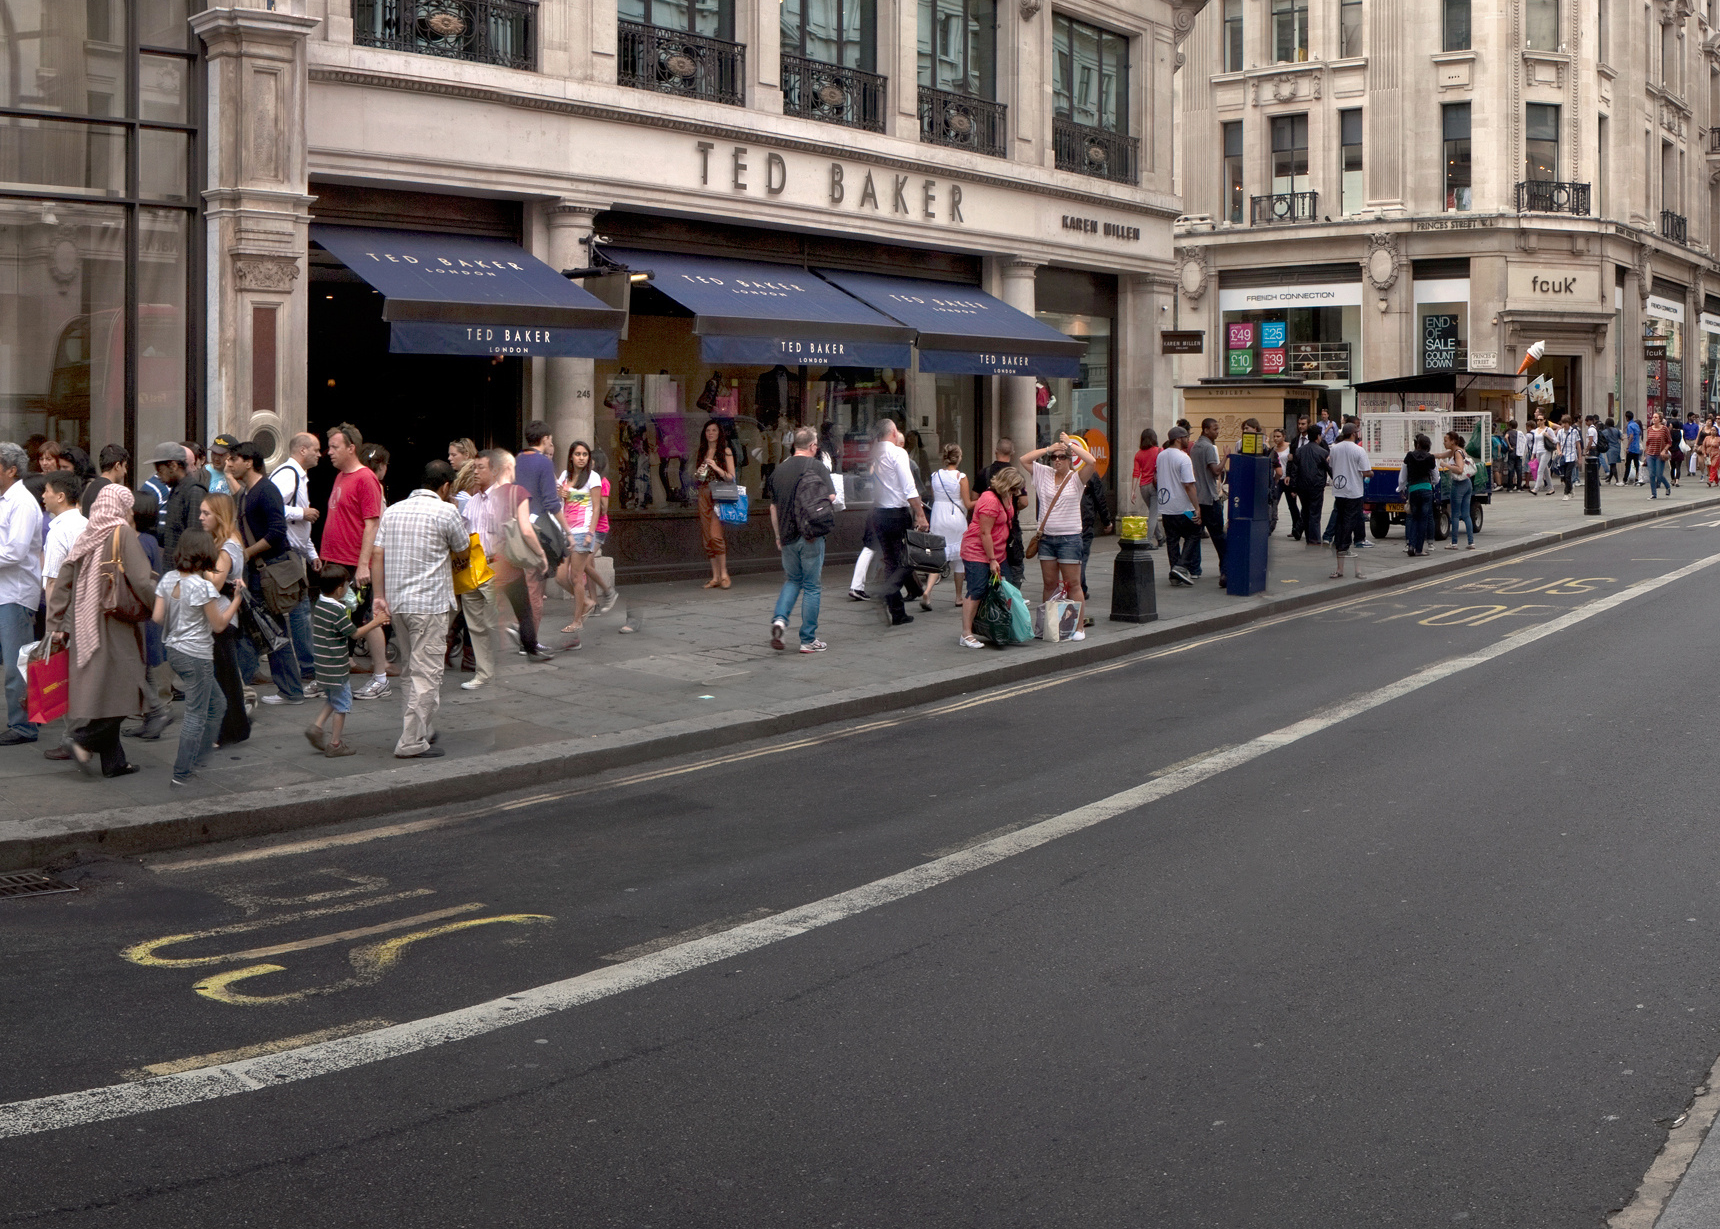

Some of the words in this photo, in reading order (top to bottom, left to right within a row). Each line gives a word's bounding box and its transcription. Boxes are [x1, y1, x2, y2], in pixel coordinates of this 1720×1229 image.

[697, 140, 787, 195] TED
[829, 162, 964, 223] BAKER
[1061, 214, 1098, 234] KAREN
[1103, 222, 1141, 241] MILLEN
[1416, 220, 1448, 230] PRINCES
[1450, 218, 1477, 228] STREET
[365, 252, 419, 264] TED
[437, 257, 524, 271] BAKER
[425, 267, 497, 277] LONDON
[681, 274, 724, 286] TED
[735, 279, 806, 292] BAKER
[1531, 275, 1575, 294] fcuk
[888, 294, 925, 304] TED
[932, 298, 989, 309] BAKER
[1246, 294, 1278, 302] FRENCH
[1279, 291, 1335, 300] CONNECTION
[1425, 316, 1450, 328] END
[467, 328, 493, 341] TED
[504, 329, 551, 343] BAKER
[1230, 328, 1251, 341] £49
[1263, 327, 1283, 340] £25
[1425, 327, 1443, 339] OF
[781, 341, 802, 353] TED
[810, 342, 845, 355] BAKER
[1425, 338, 1456, 350] SALE
[1263, 353, 1284, 366] £39
[1425, 351, 1456, 360] COUNT
[1646, 349, 1663, 357] fcuk
[979, 354, 996, 365] TED
[1002, 355, 1029, 367] BAKER
[1230, 354, 1250, 367] £10
[1425, 359, 1453, 368] DOWN
[576, 390, 591, 399] 245
[1090, 446, 1107, 459] NAL
[1440, 576, 1618, 596] BUS
[1313, 602, 1563, 627] STOP
